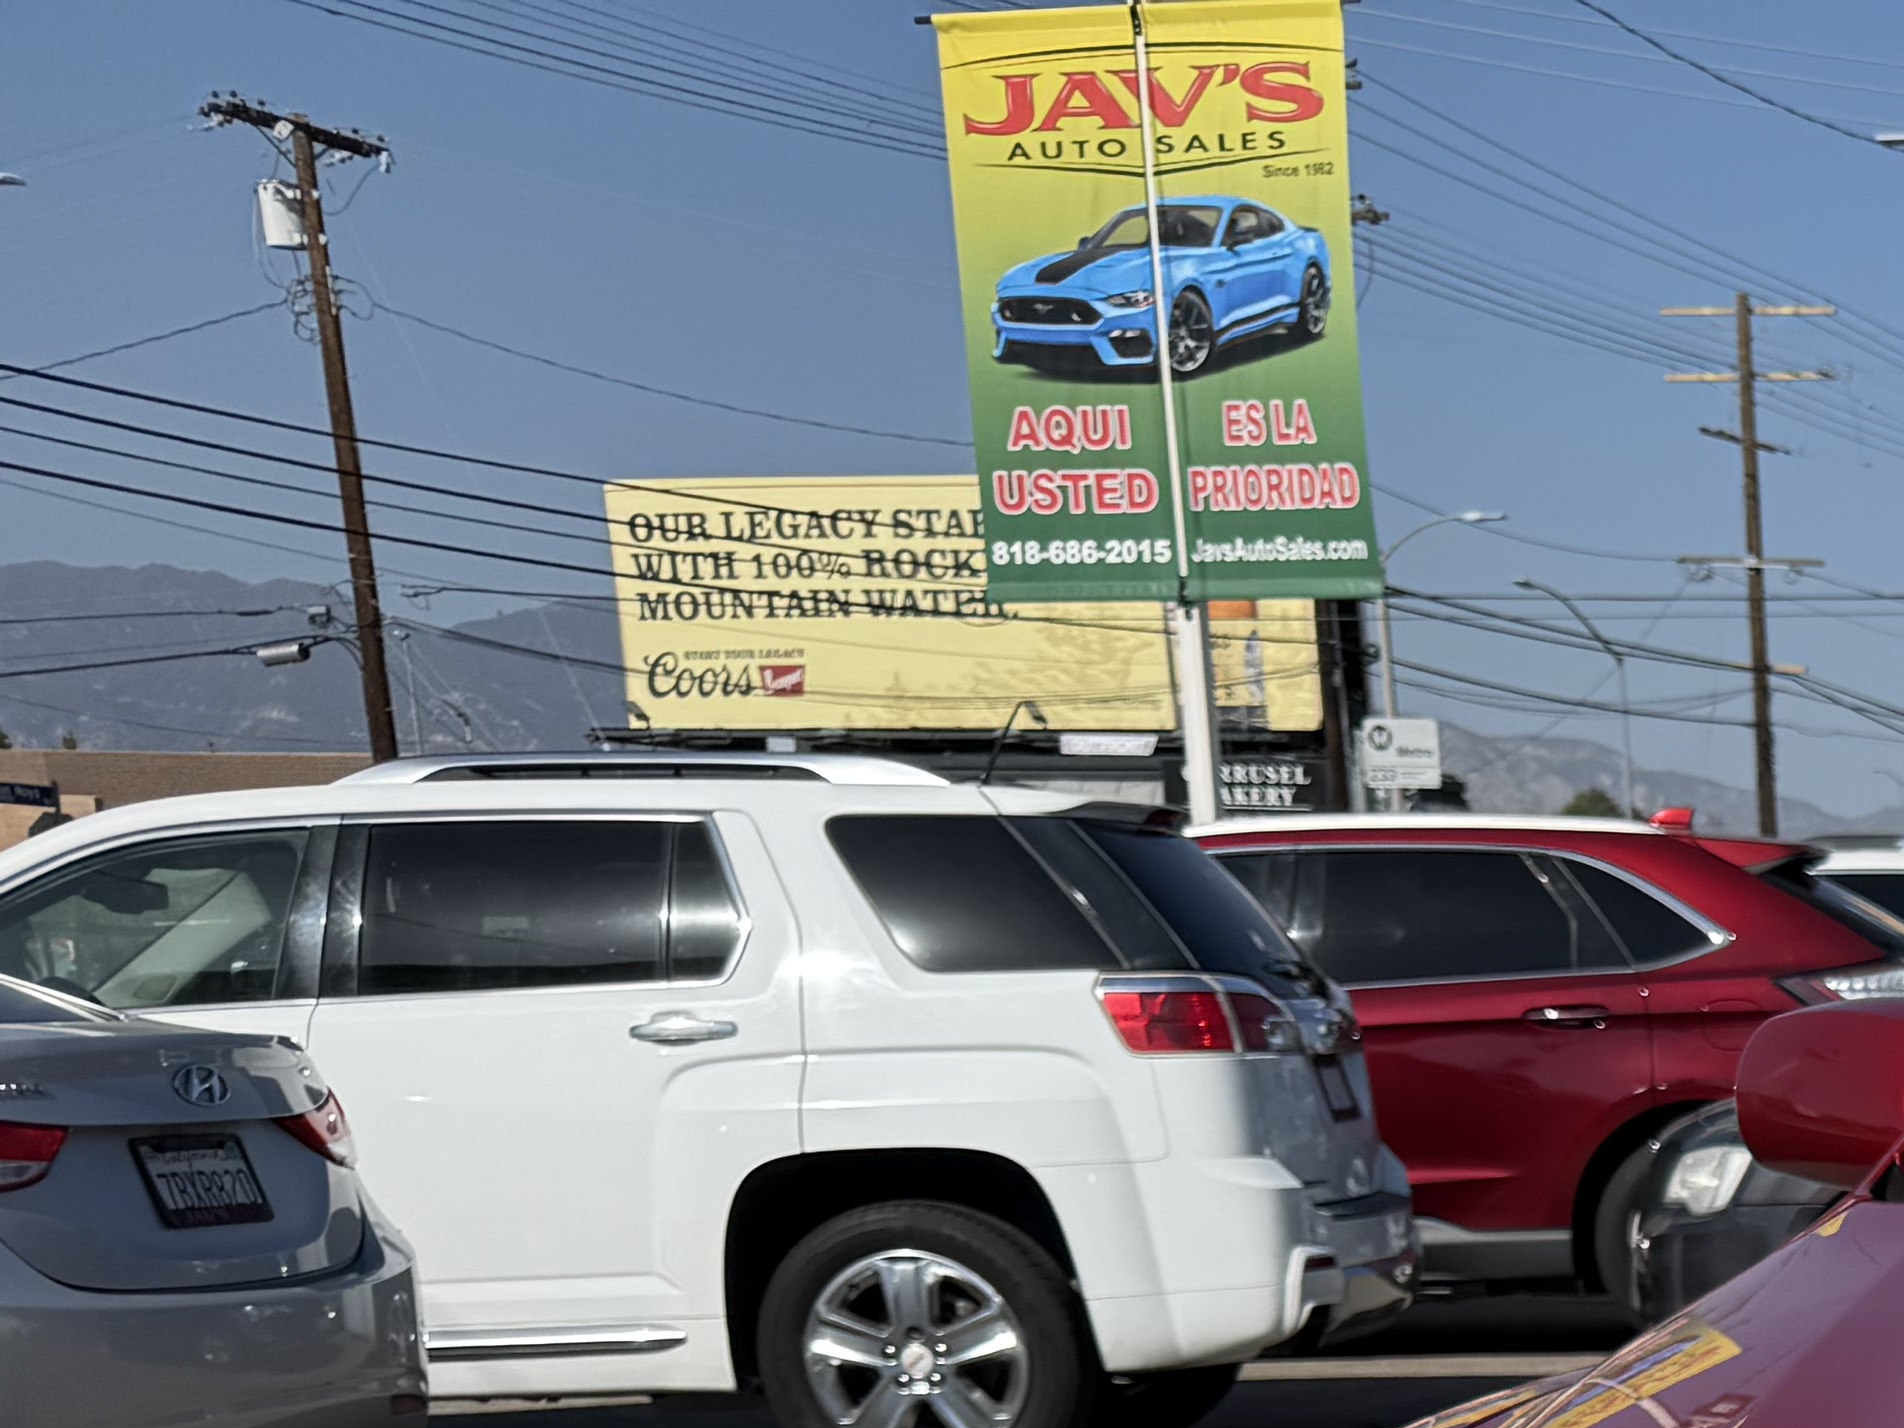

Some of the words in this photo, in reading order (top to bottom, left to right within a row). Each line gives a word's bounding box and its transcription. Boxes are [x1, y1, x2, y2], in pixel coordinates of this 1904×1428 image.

[963, 61, 1326, 137] JAV'S
[1006, 138, 1127, 162] AUTO
[1155, 130, 1287, 154] SALES
[1007, 405, 1132, 454] AQUI
[1222, 401, 1265, 447] ES
[1273, 398, 1317, 445] LA
[992, 469, 1160, 515] USTED
[1187, 463, 1361, 512] PRIORIDAD
[628, 512, 710, 543] OUR
[718, 509, 879, 541] LEGACY
[632, 551, 738, 580] WITH
[752, 551, 852, 580] 100%
[991, 540, 1172, 566] 818-686-2015
[637, 589, 853, 621] MOUNTAIN
[643, 651, 753, 698] Coors
[1181, 763, 1312, 786] RRUSEL
[1218, 785, 1297, 806] AKERY
